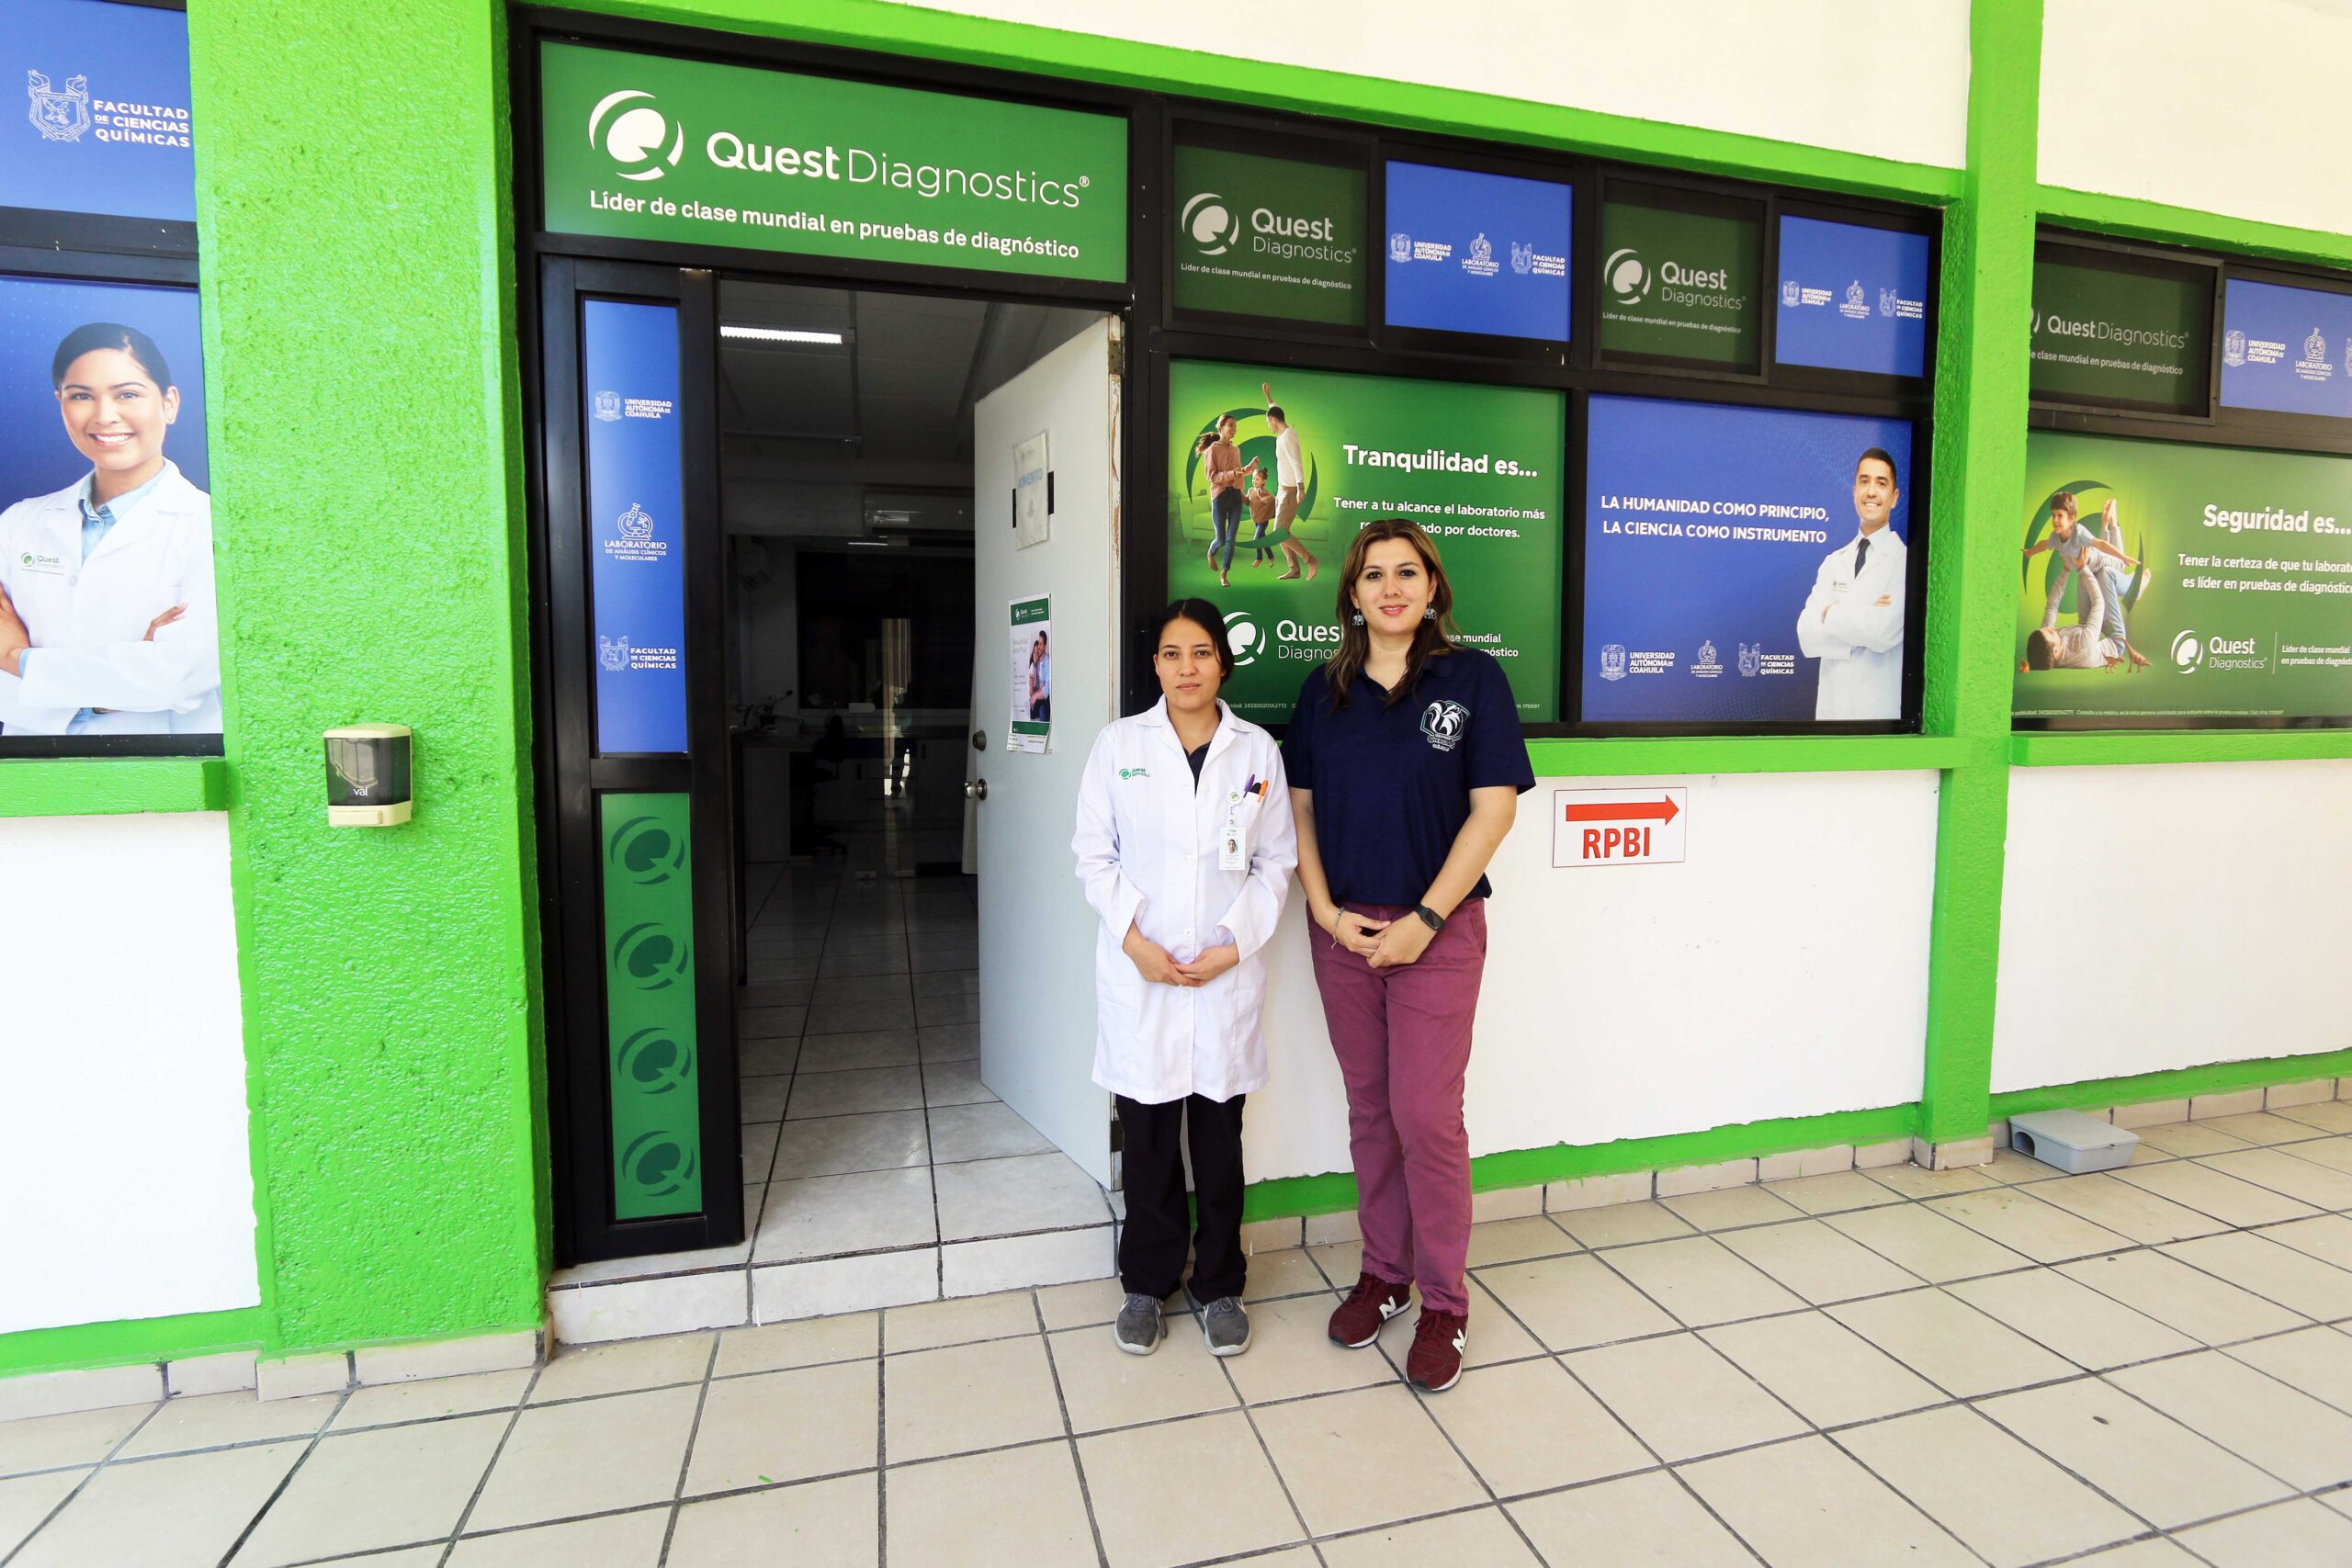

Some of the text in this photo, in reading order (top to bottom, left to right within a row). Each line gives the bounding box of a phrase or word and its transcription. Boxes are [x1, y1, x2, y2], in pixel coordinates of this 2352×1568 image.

[93, 99, 189, 120] FACULTAD
[95, 114, 190, 134] DE CIENCIAS
[95, 128, 191, 148] QUÍMICAS
[707, 131, 841, 180] Quest
[590, 190, 1080, 258] Líder de clase mundial en pruebas de diagnóstico
[1251, 208, 1333, 241] Quest
[1414, 242, 1452, 251] UNIVERSIDAD
[1414, 254, 1443, 262] COAHUILA
[1462, 258, 1499, 268] LABORATORIO
[1532, 254, 1566, 264] FACULTAD
[1201, 265, 1210, 274] de
[1211, 266, 1231, 276] clase
[1232, 269, 1261, 279] mundial
[1272, 274, 1301, 285] pruebas
[1312, 278, 1351, 289] diagnóstico
[1532, 267, 1565, 276] QUÍMICAS
[1661, 261, 1727, 290] Quest
[1895, 310, 1923, 319] QUÍMICAS
[1645, 317, 1668, 325] mundial
[1677, 321, 1700, 329] pruebas
[2047, 315, 2096, 338] Quest
[2248, 340, 2286, 351] UNIVERSIDAD
[2037, 350, 2057, 361] clase
[2058, 354, 2089, 365] mundial
[2090, 357, 2099, 366] en
[2100, 357, 2131, 369] pruebas
[2132, 361, 2141, 370] de
[2142, 361, 2183, 375] diagnóstico
[2247, 355, 2276, 364] COAHUILA
[2295, 360, 2333, 371] LABORATORIO
[625, 399, 673, 407] UNIVERSIDAD
[625, 411, 662, 419] COAHUILA
[1342, 444, 1538, 478] Tranquilidad es...
[1333, 497, 1545, 520] Tener a tu alcance el laboratorio más
[1601, 495, 1830, 523] LA HUMANIDAD COMO PRINCIPIO,
[2203, 504, 2309, 533] Seguridad
[1444, 525, 1464, 537] por
[1467, 525, 1521, 538] doctores.
[1603, 520, 1826, 544] LA CIENCIA COMO INSTRUMENTO
[605, 540, 667, 549] LABORATORIO
[2178, 553, 2210, 567] Tener
[2211, 555, 2222, 568] la
[2223, 558, 2262, 570] certeza
[2265, 558, 2278, 570] de
[2280, 560, 2300, 572] que
[2301, 559, 2312, 571] tu
[2182, 577, 2196, 588] es
[2198, 576, 2222, 589] líder
[2223, 579, 2237, 590] en
[2239, 579, 2282, 592] pruebas
[2284, 580, 2298, 592] de
[1463, 633, 1501, 643] mundial
[2209, 636, 2256, 655] Quest
[2299, 645, 2308, 654] de
[2308, 645, 2324, 654] clase
[2324, 645, 2350, 654] mundial
[1629, 651, 1675, 660] UNIVERSIDAD
[2281, 657, 2290, 665] en
[2290, 657, 2315, 666] pruebas
[2316, 657, 2324, 665] de
[630, 661, 677, 670] QUÍMICAS
[1629, 659, 1668, 667] AUTÓNOMA
[1629, 666, 1664, 674] COAHUILA
[1760, 667, 1794, 675] QUÍMICAS
[1582, 827, 1650, 859] RPBI
